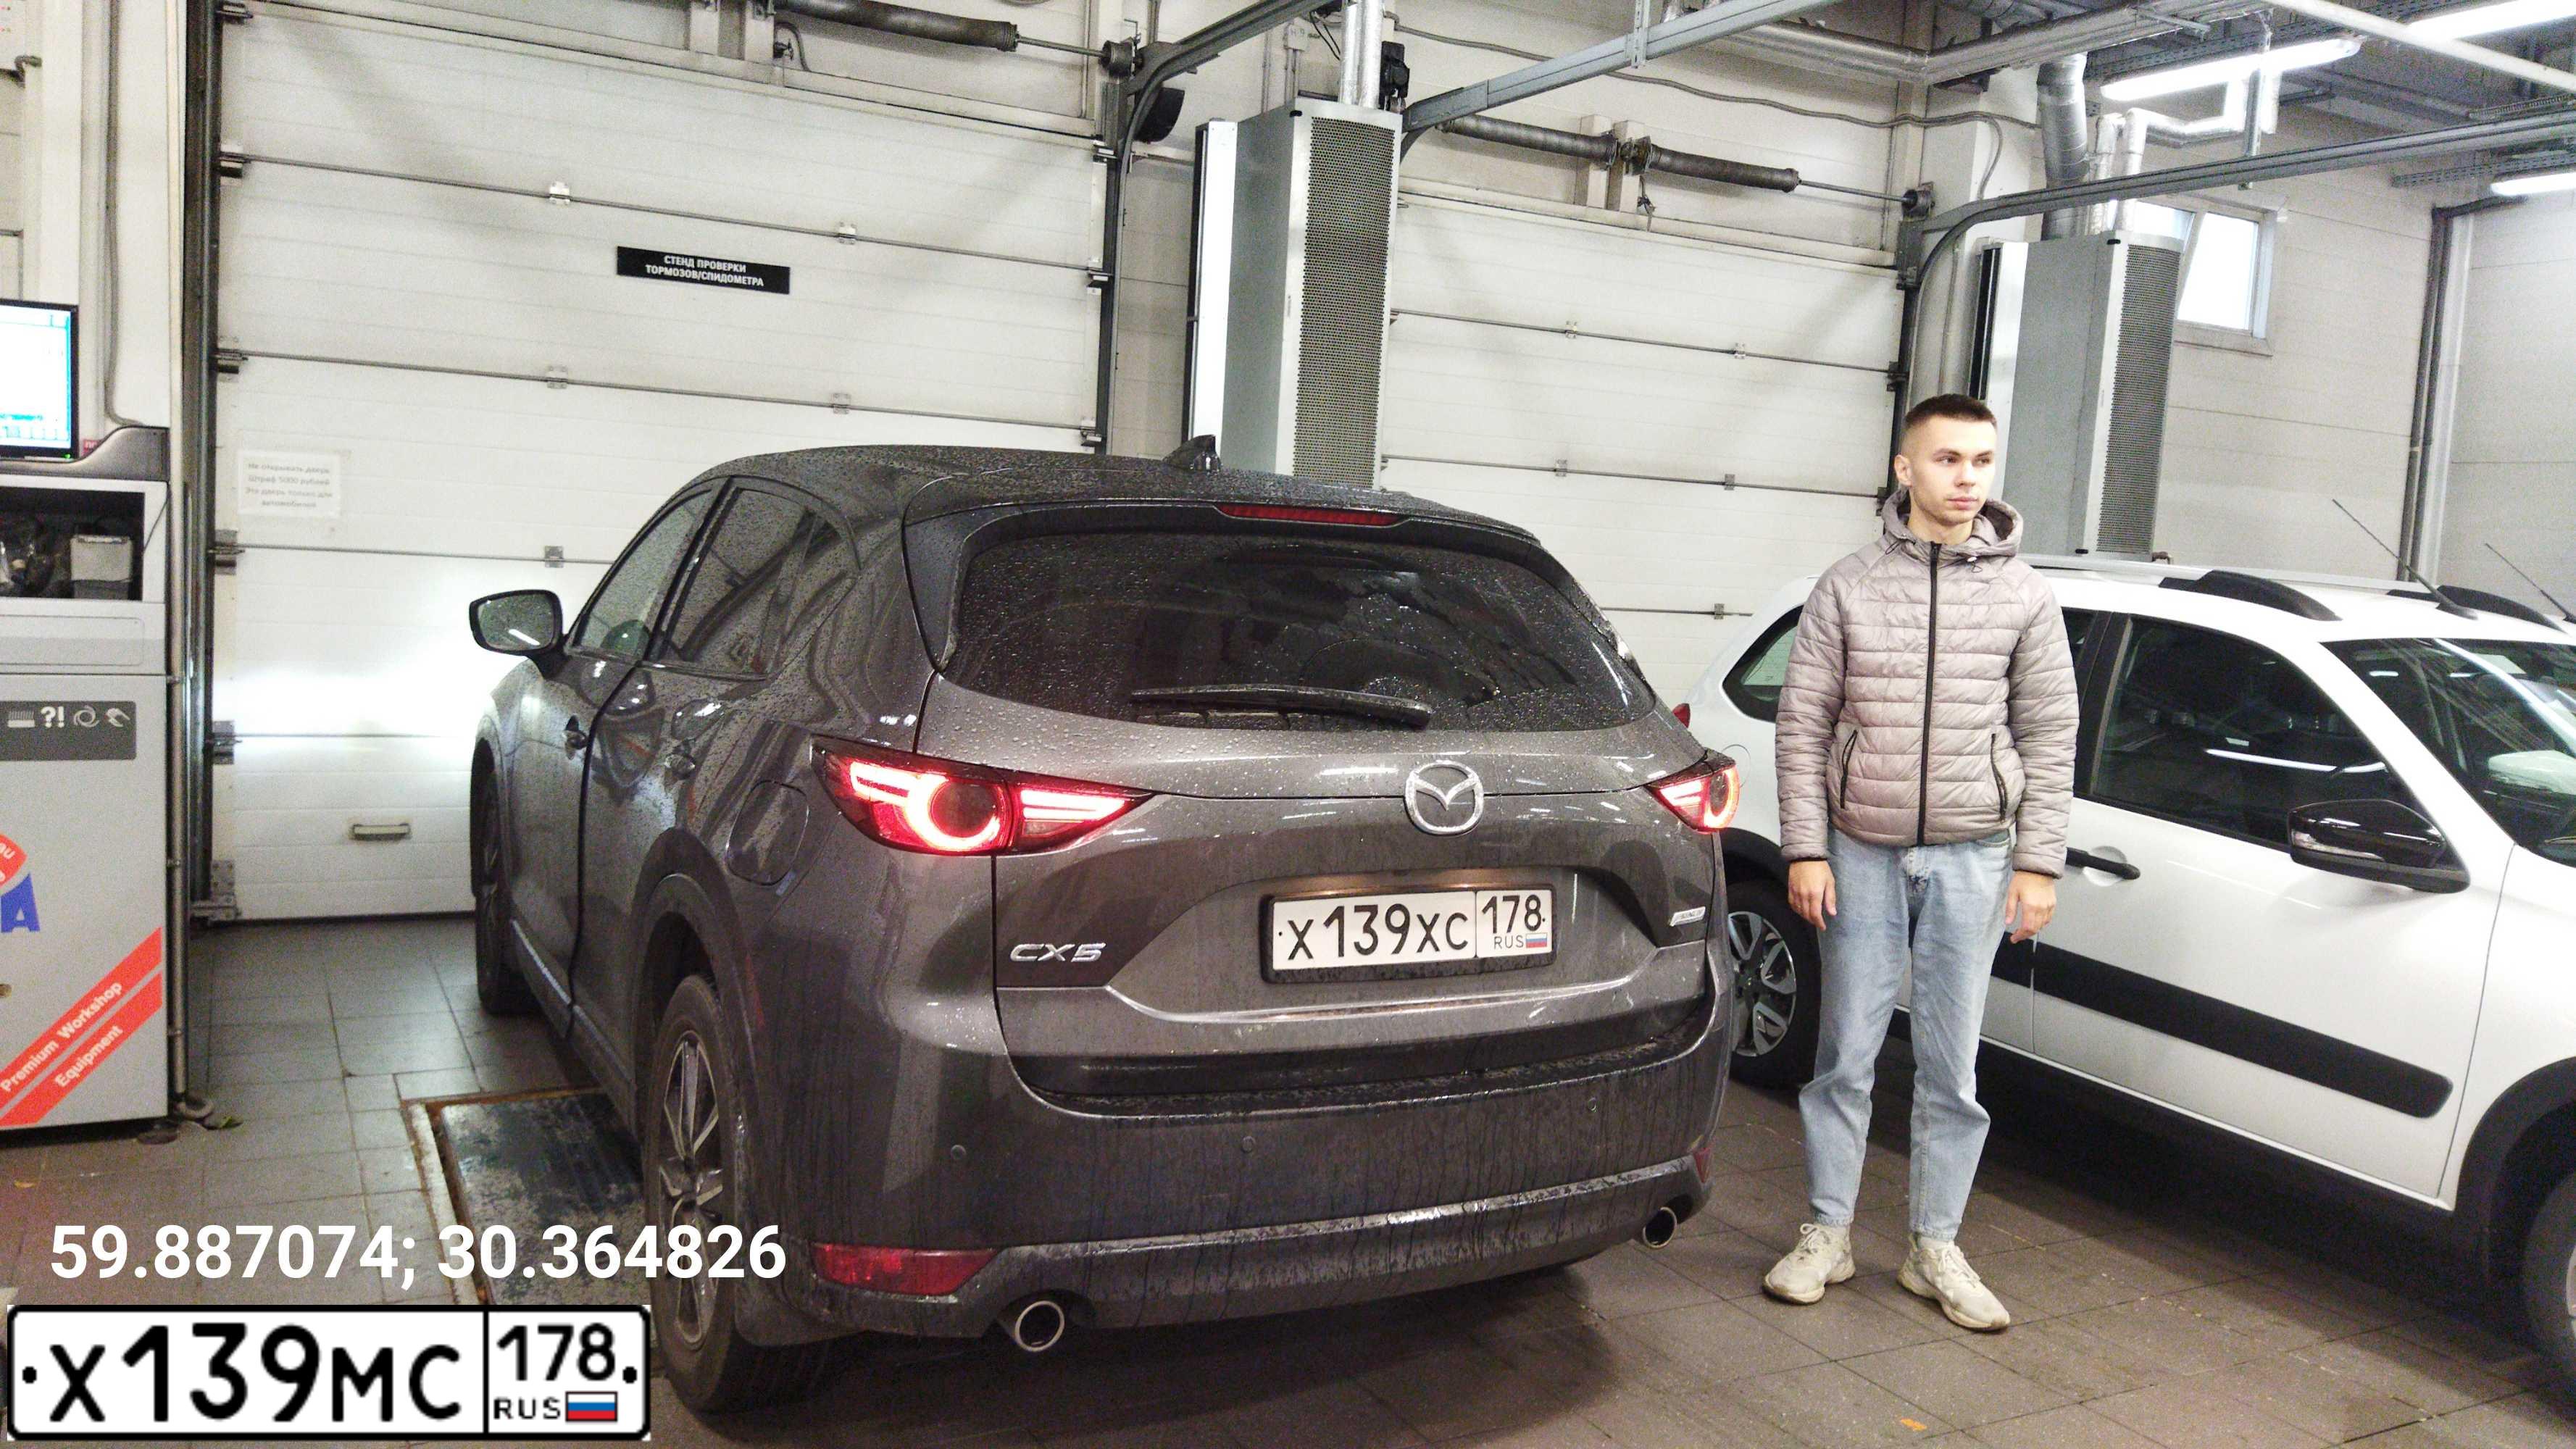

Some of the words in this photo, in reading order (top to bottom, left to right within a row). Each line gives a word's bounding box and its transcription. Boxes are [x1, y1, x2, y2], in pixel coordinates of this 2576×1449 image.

[645, 264, 764, 286] ТОРМОЗОВ/СПИДОМЕТРА
[664, 254, 695, 268] СТЕНД
[696, 259, 746, 273] ПРОВЕРКИ
[1481, 895, 1542, 933] 178
[1493, 935, 1524, 949] RUS
[1, 1040, 59, 1092] Premium
[57, 982, 122, 1038] Workshop
[54, 1025, 123, 1087] Equipment
